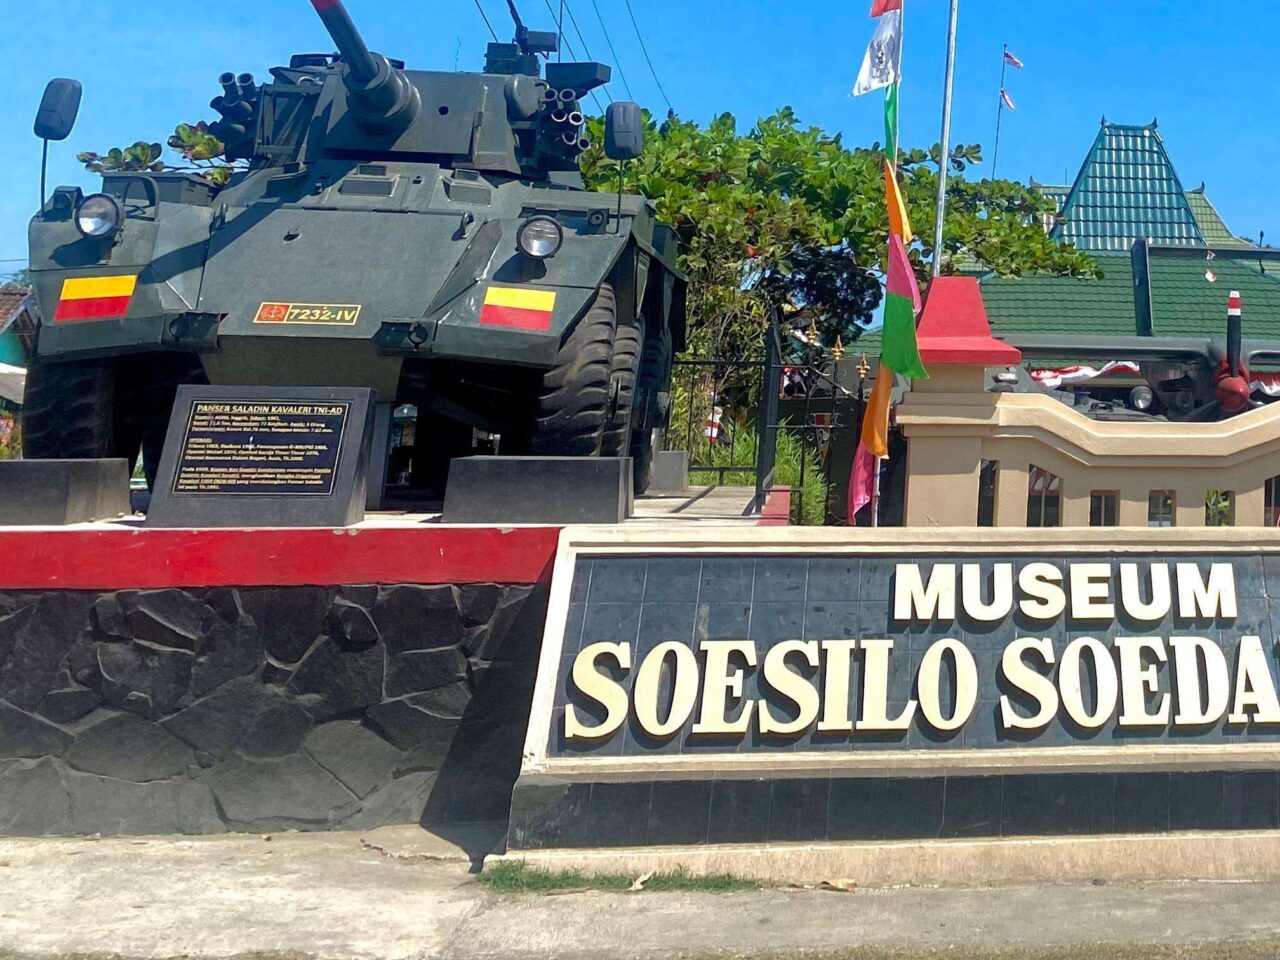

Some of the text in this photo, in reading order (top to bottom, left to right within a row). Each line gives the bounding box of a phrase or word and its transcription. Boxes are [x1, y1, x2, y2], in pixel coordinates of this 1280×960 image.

[290, 309, 356, 321] 7232-IV
[197, 404, 343, 415] PANSER SALADIN KAVALERI TNI-AD
[892, 562, 1239, 621] MUSEUM
[564, 637, 979, 739] SOESILO
